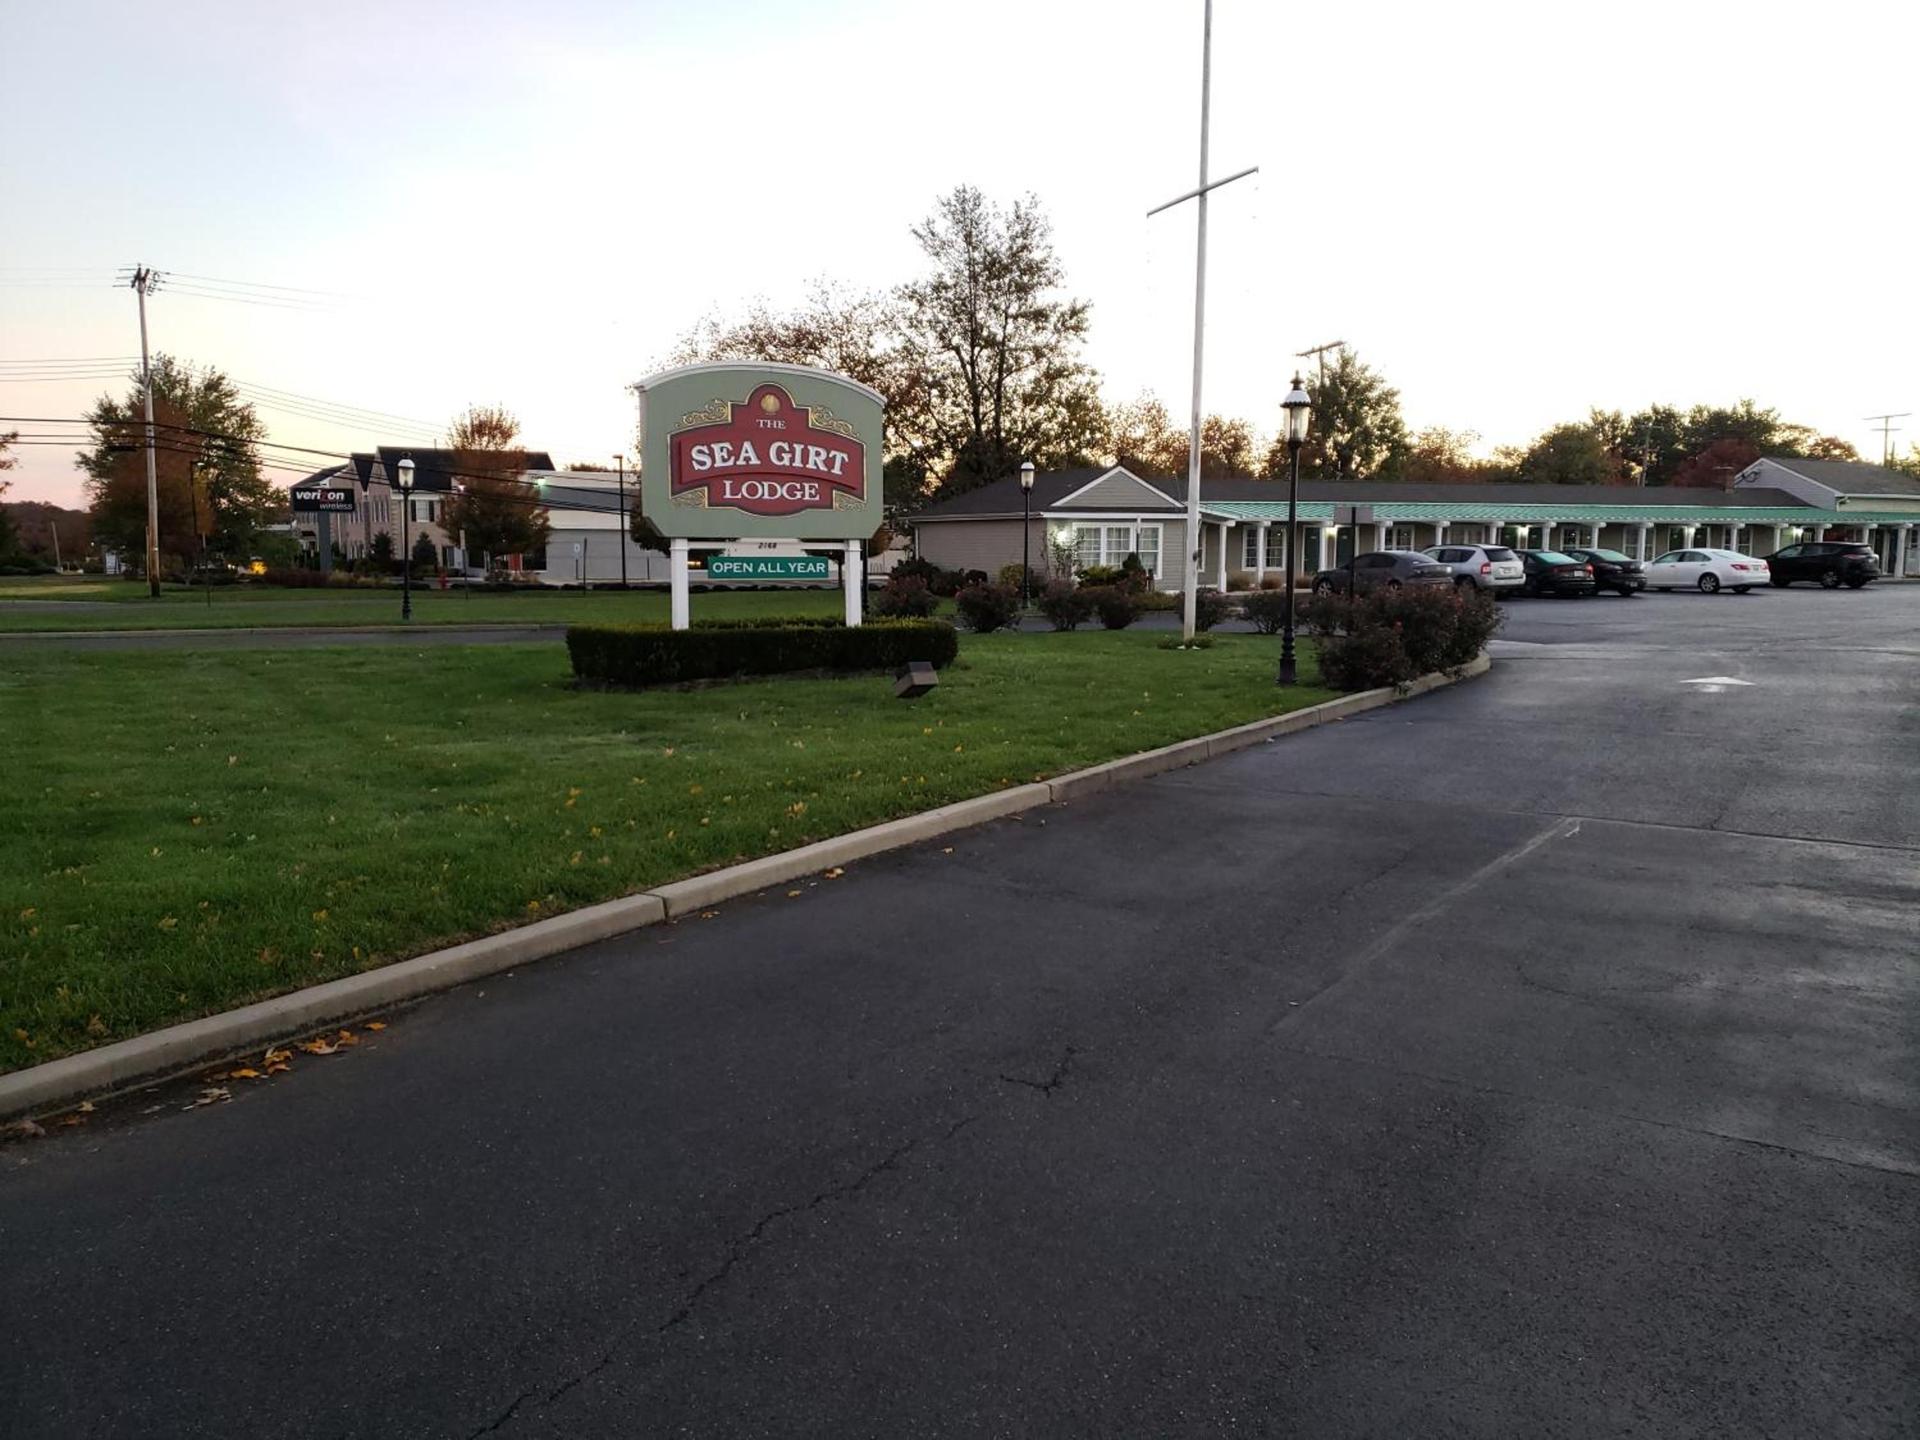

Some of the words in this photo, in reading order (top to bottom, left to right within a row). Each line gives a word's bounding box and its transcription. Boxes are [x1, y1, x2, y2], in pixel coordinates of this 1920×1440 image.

[756, 419, 786, 429] THE
[691, 441, 761, 471] SEA
[769, 441, 849, 475] GIRT
[723, 480, 820, 500] LODGE
[712, 562, 753, 573] OPEN
[758, 562, 785, 573] ALL
[788, 562, 826, 573] YEAR
